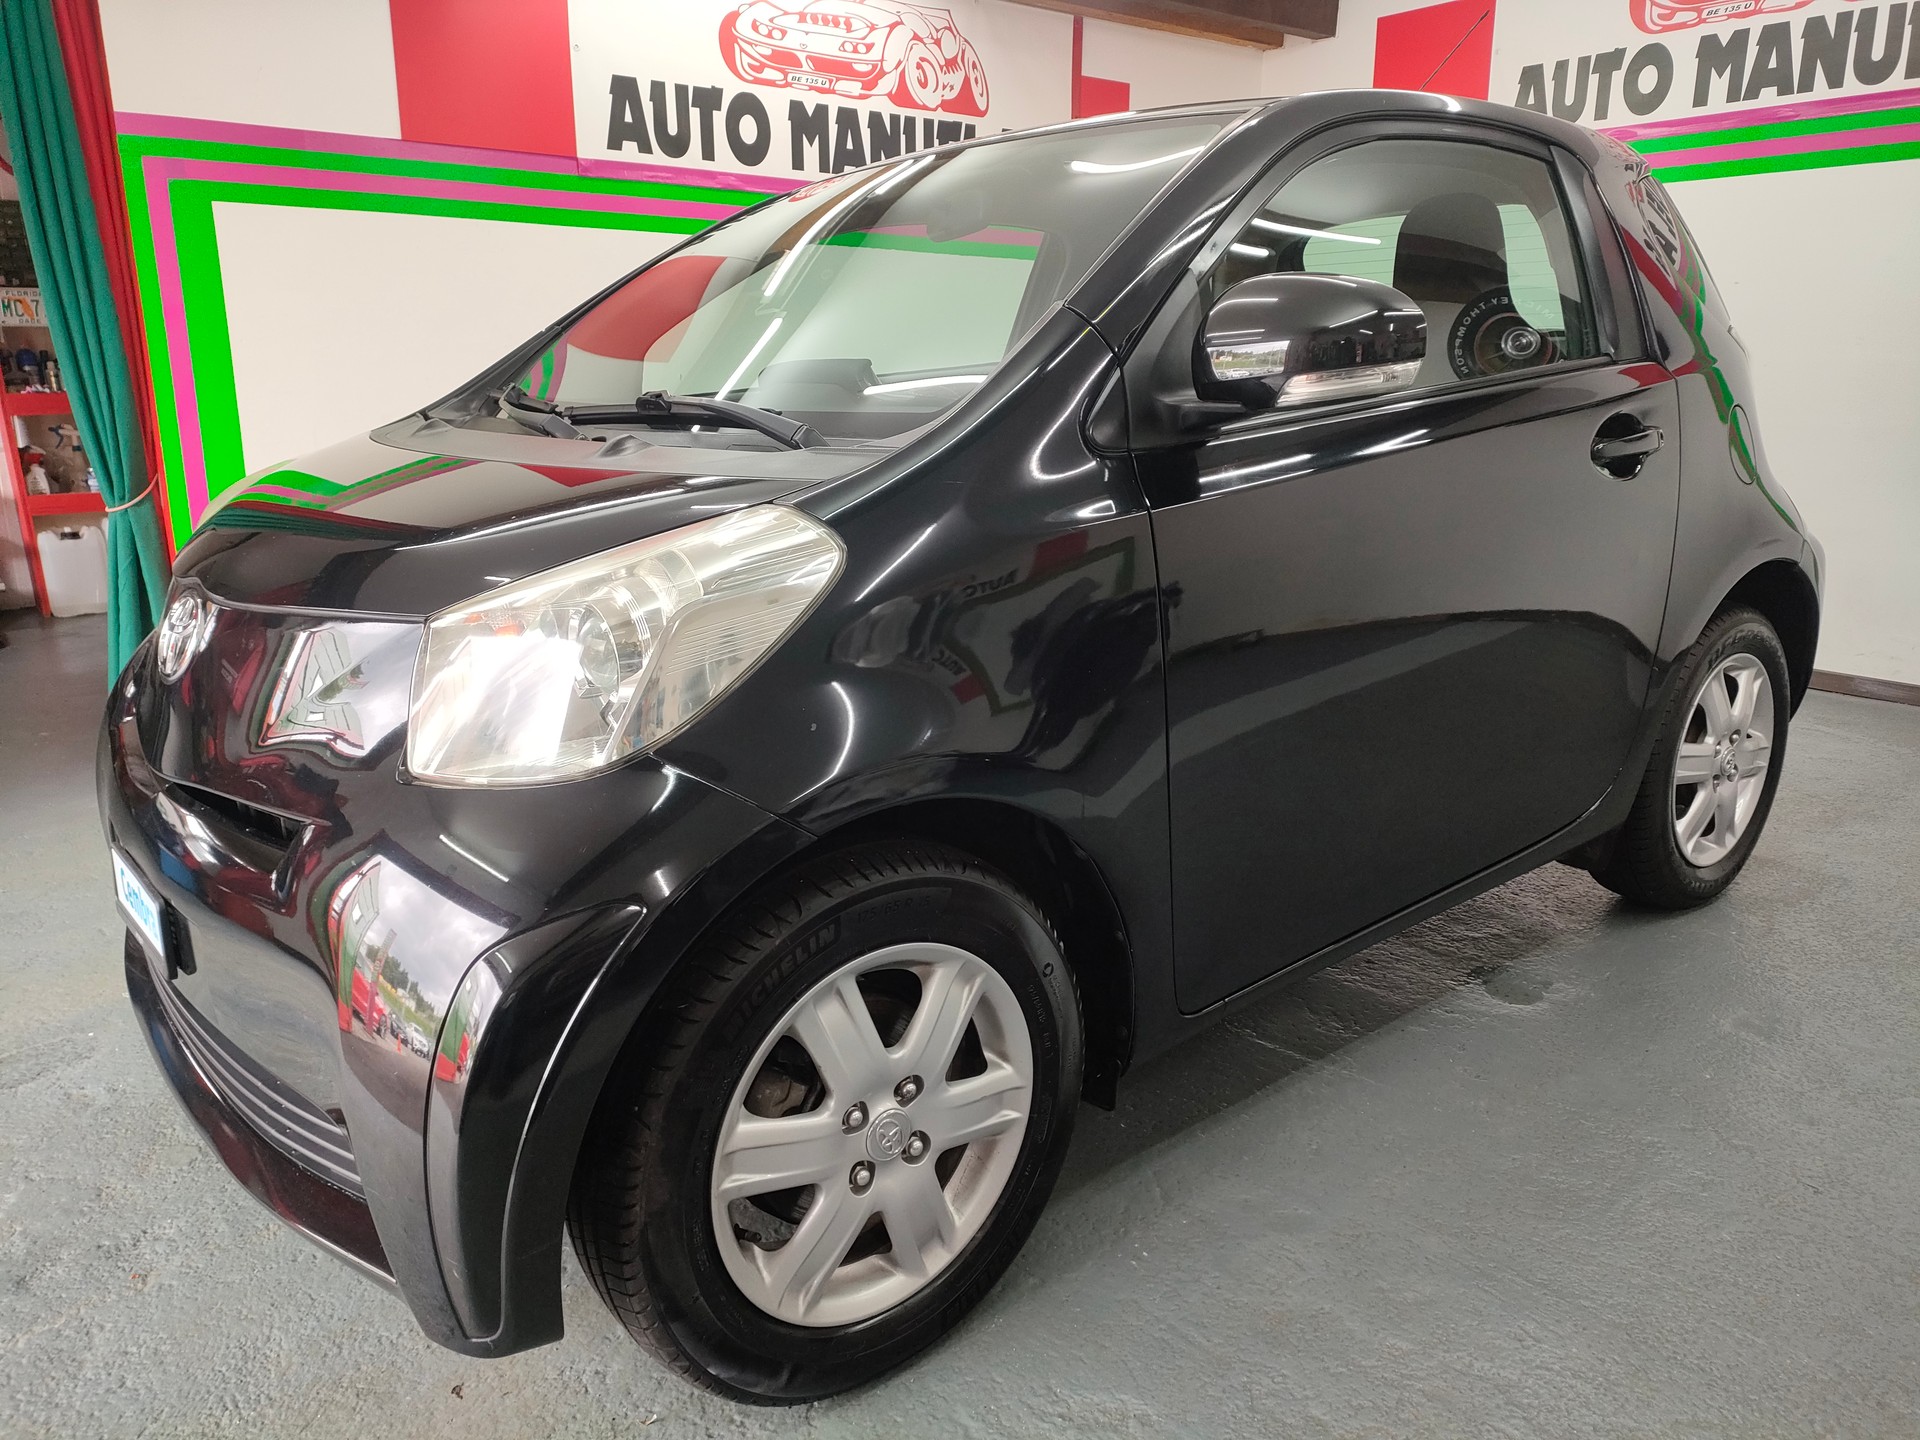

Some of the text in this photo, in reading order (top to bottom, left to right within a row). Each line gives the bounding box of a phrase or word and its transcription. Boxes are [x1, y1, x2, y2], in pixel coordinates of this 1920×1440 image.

[1706, 2, 1753, 17] BE 135 U
[790, 75, 828, 87] BE 135 U
[1514, 42, 1674, 124] AUTO
[606, 74, 771, 167] AUTO
